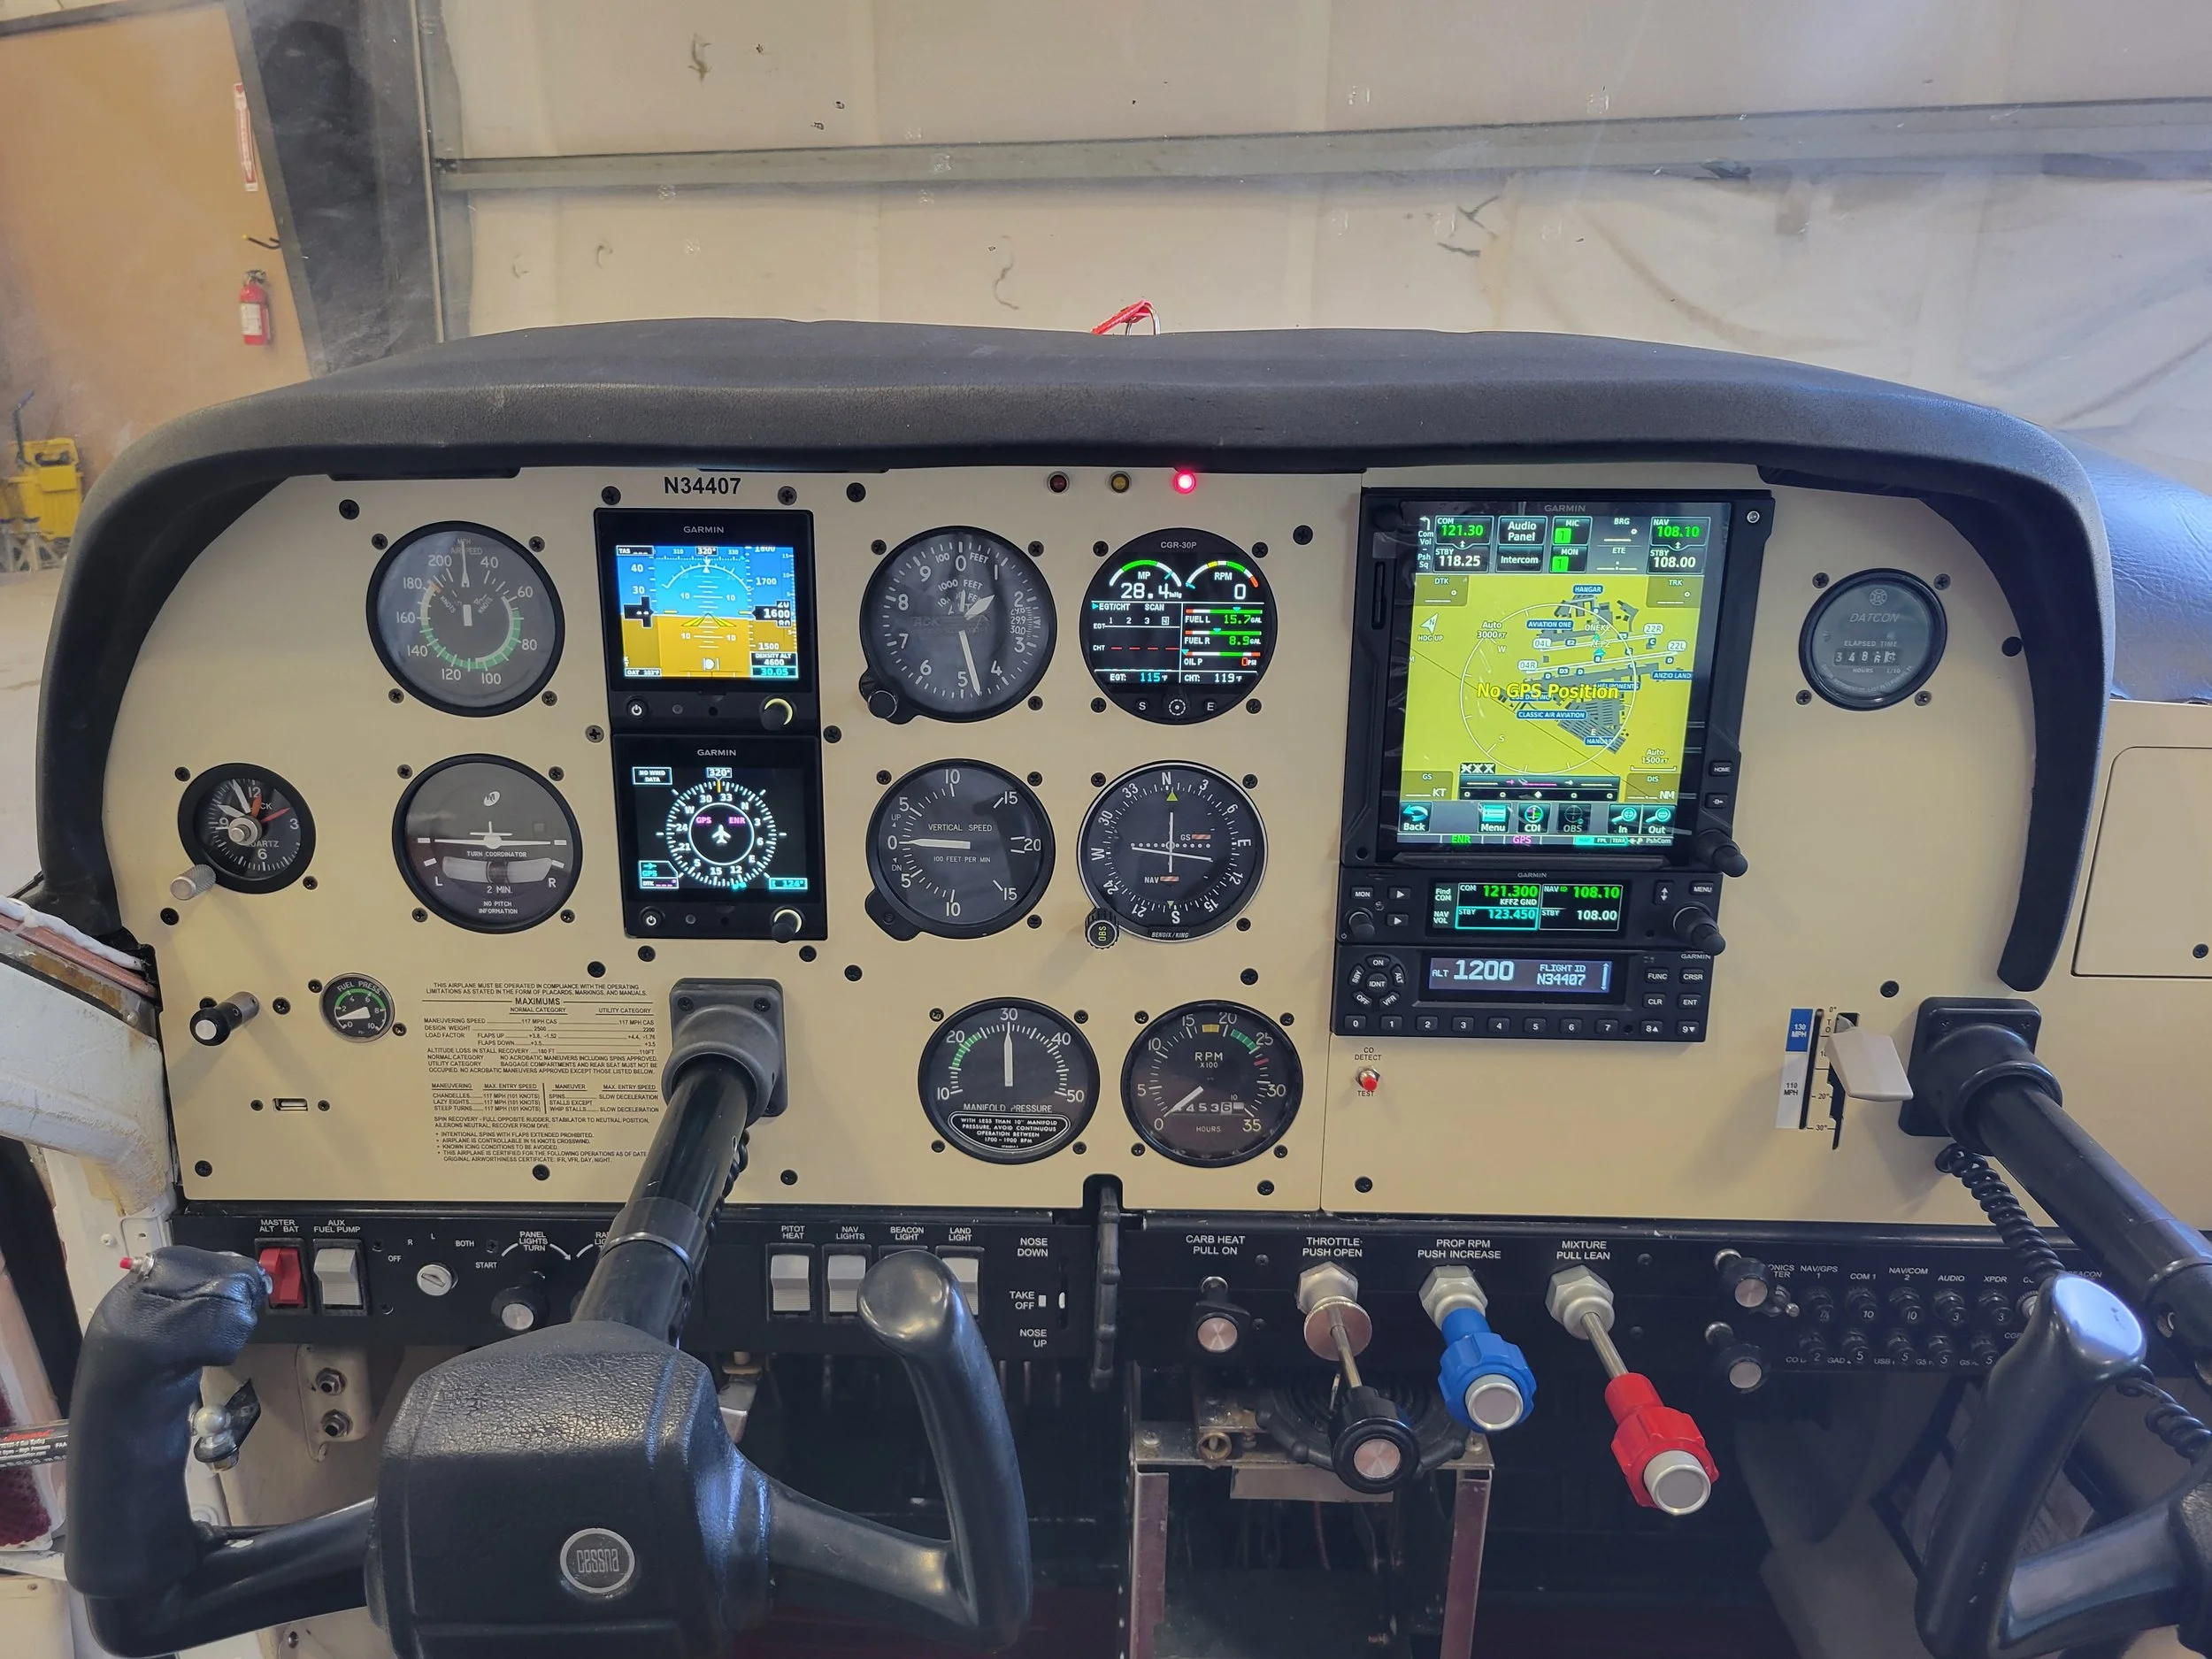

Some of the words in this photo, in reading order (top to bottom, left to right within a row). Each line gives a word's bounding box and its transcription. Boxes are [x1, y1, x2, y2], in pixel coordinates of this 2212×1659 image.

[664, 476, 741, 495] N34407
[1442, 525, 1483, 536] 121.30
[1508, 521, 1536, 530] Audio
[1657, 526, 1700, 537] 108.10
[428, 555, 451, 566] 200
[480, 557, 498, 568] 40
[936, 553, 949, 563] 100
[970, 553, 988, 564] FEET
[1440, 556, 1480, 566] 118.25
[1654, 557, 1695, 567] 108.00
[919, 566, 931, 581] 9
[938, 580, 958, 591] 1000
[964, 580, 983, 589] FEET
[898, 594, 909, 611] 8
[397, 611, 415, 623] 160
[764, 609, 790, 618] 1600
[1849, 613, 1901, 622] DATCON
[522, 639, 537, 650] 80
[442, 669, 461, 680] 120
[1478, 684, 1501, 698] No
[1507, 684, 1541, 697] GPS
[1549, 684, 1618, 698] Position
[1162, 772, 1171, 785] N
[249, 787, 260, 797] 12
[290, 818, 299, 829] 3
[1024, 839, 1041, 851] 20
[258, 849, 267, 859] 6
[435, 877, 442, 886] L
[549, 878, 556, 887] R
[1484, 886, 1538, 897] 121.300
[1574, 887, 1619, 898] 108.10
[1489, 910, 1535, 919] 123.450
[1578, 910, 1617, 920] 108.00
[1454, 960, 1515, 981] 1200
[1537, 973, 1586, 986] N34407
[337, 981, 355, 991] FUEL
[358, 981, 381, 995] PRESS.
[1001, 1008, 1018, 1020] 30
[1195, 1052, 1223, 1061] RPM
[1067, 1090, 1084, 1102] 50
[1242, 1119, 1261, 1132] 35
[1186, 1235, 1215, 1244] CARB
[1217, 1235, 1245, 1245] HEAT
[1306, 1237, 1359, 1247] THROTTLE
[1436, 1239, 1462, 1248] PROP
[1464, 1240, 1490, 1248] RPM
[1563, 1240, 1606, 1250] MIXTURE
[1193, 1246, 1219, 1256] PULL
[1223, 1246, 1238, 1256] ON
[1302, 1248, 1331, 1257] PUSH
[1333, 1248, 1363, 1257] OPEN
[1417, 1249, 1446, 1259] PUSH
[1449, 1249, 1501, 1259] INCREASE
[577, 1548, 618, 1572] cessna
